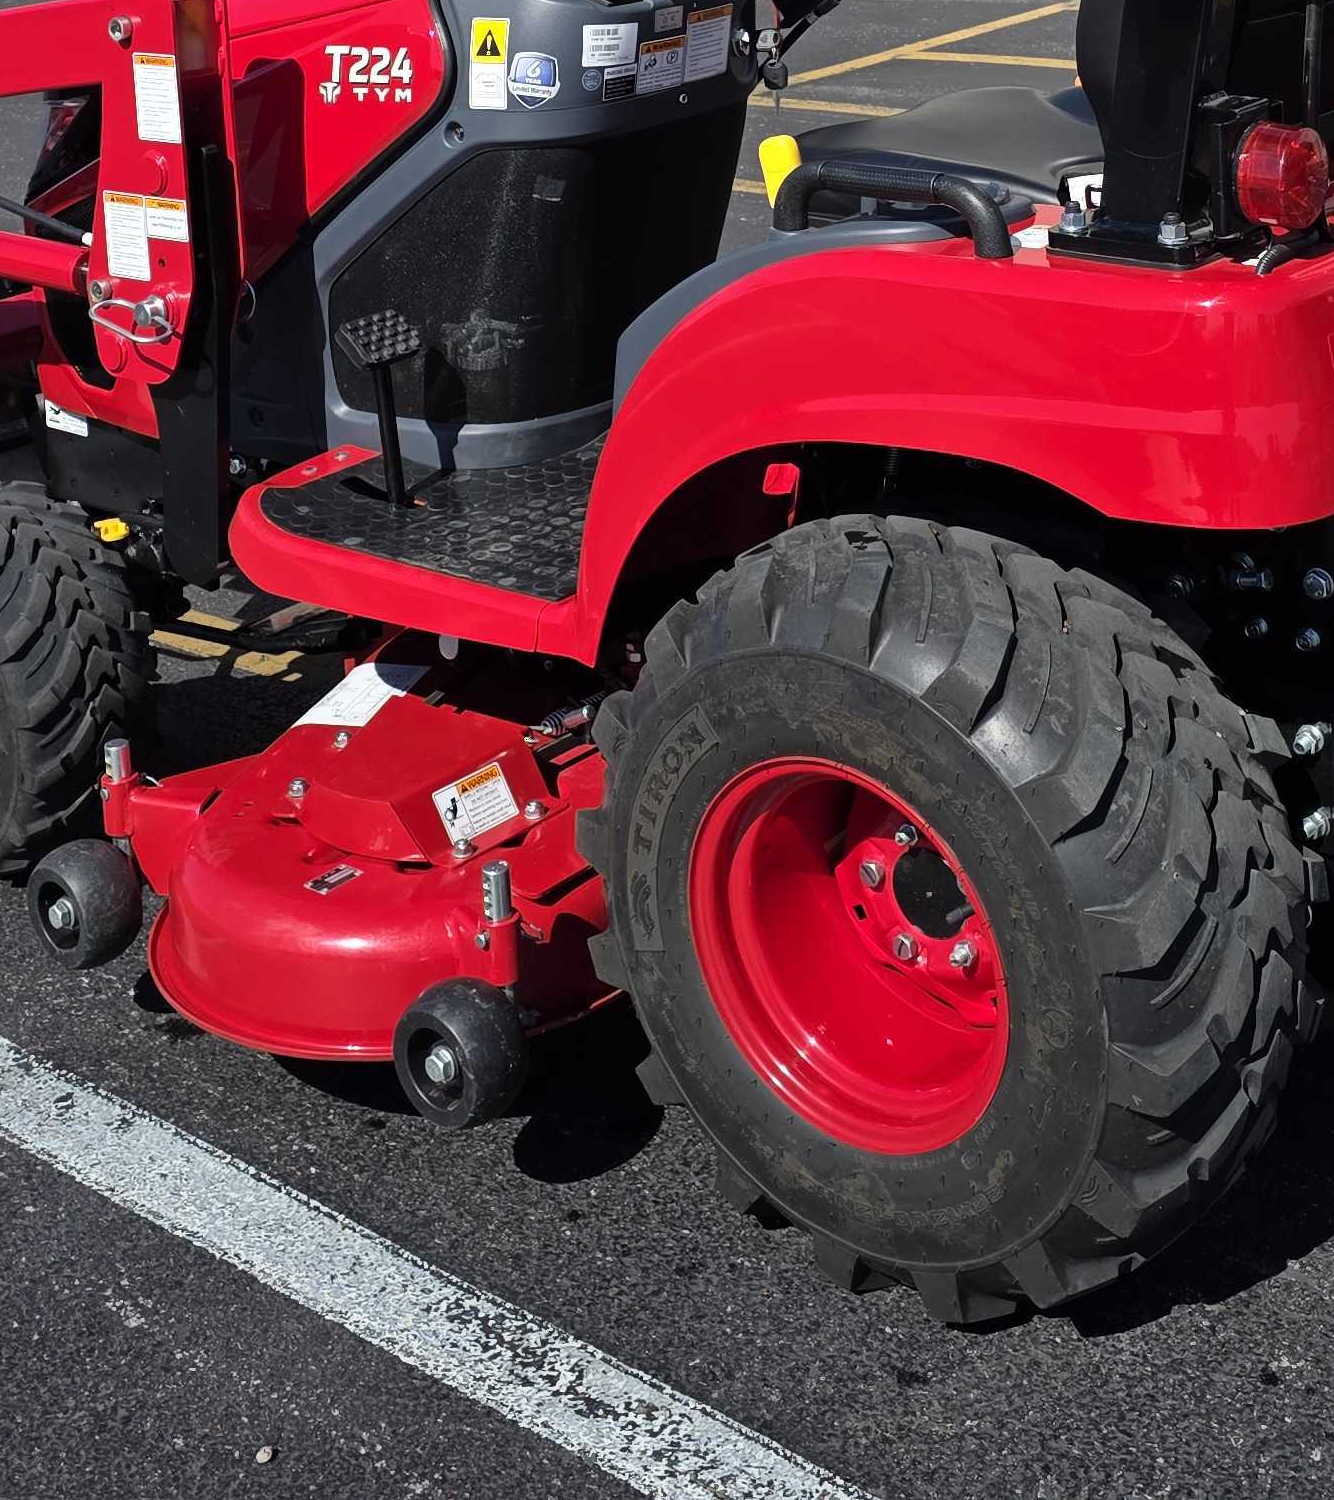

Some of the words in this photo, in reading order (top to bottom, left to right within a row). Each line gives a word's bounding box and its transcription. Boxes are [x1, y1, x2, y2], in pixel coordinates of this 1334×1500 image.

[325, 45, 413, 84] T224
[526, 59, 543, 78] 6
[352, 87, 412, 103] TYM
[467, 768, 499, 790] WARNING
[632, 721, 706, 854] TIRON
